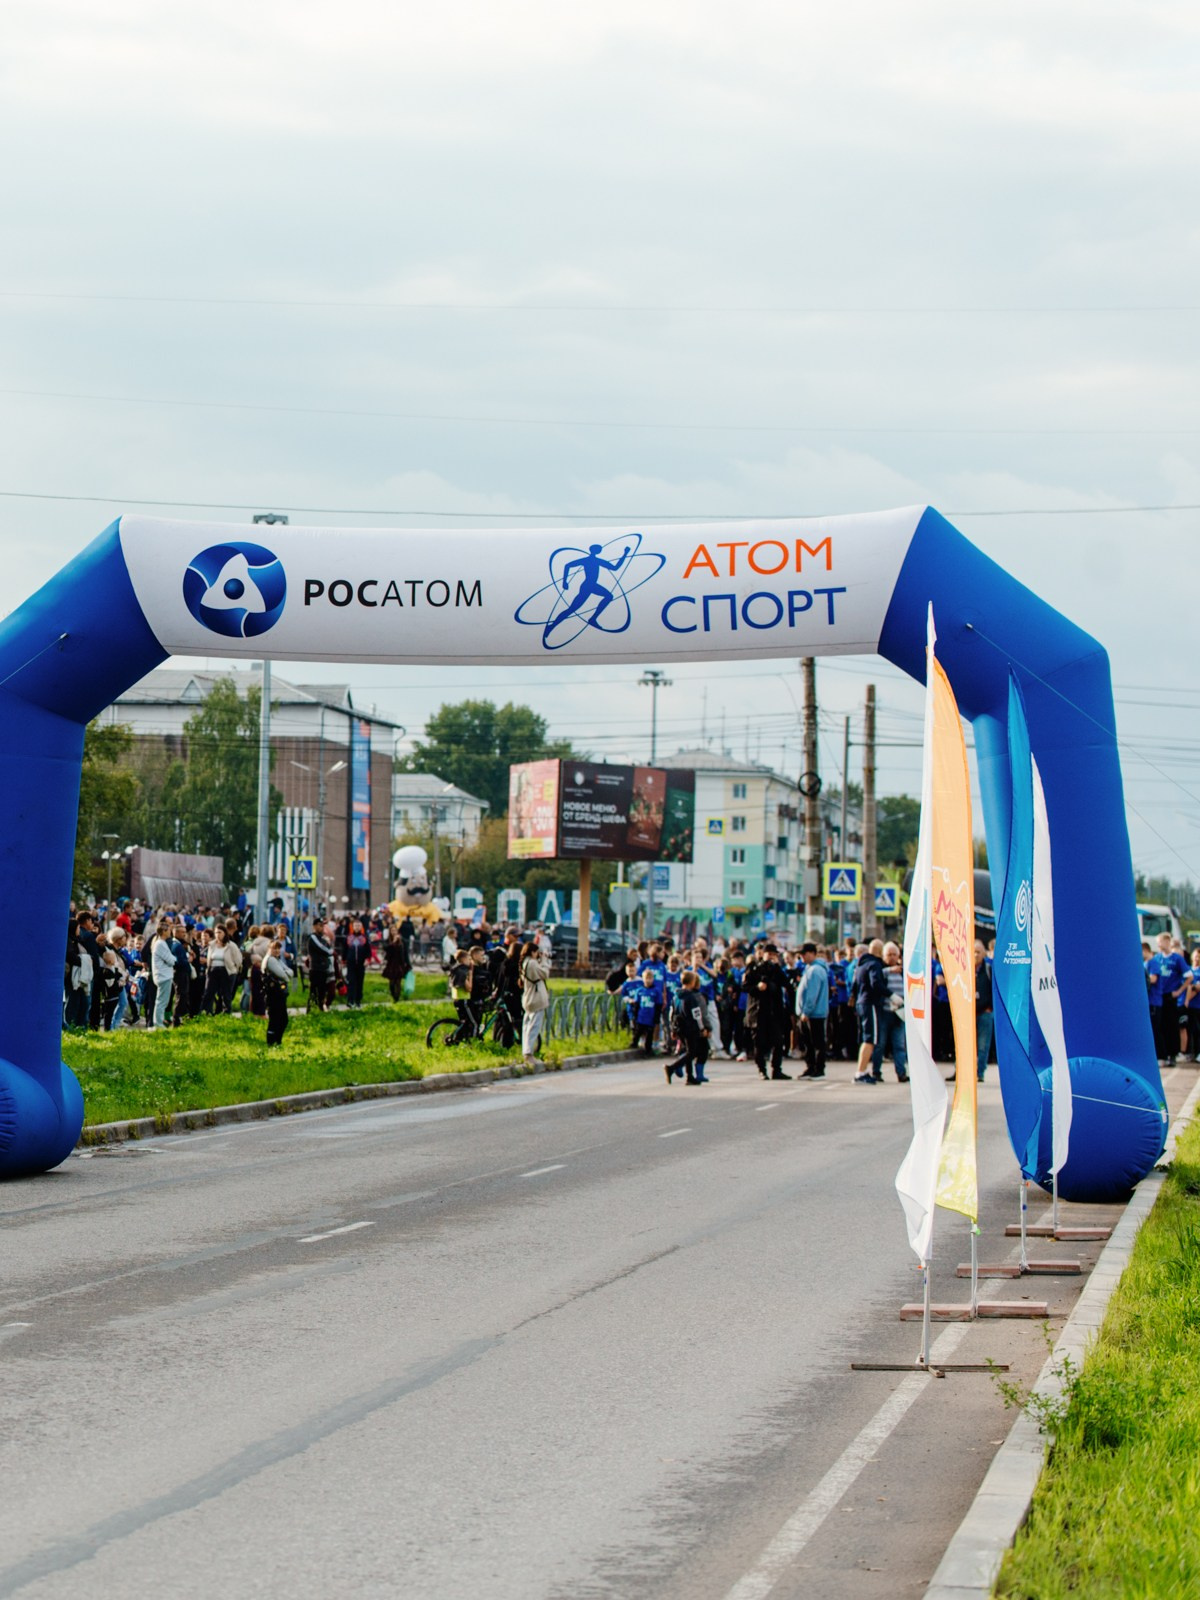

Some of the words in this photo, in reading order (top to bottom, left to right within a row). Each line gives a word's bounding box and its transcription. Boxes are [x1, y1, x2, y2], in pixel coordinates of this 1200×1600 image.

[682, 536, 833, 580] АТОМ
[303, 578, 483, 608] РОСАТОМ
[660, 586, 847, 633] СПОРТ
